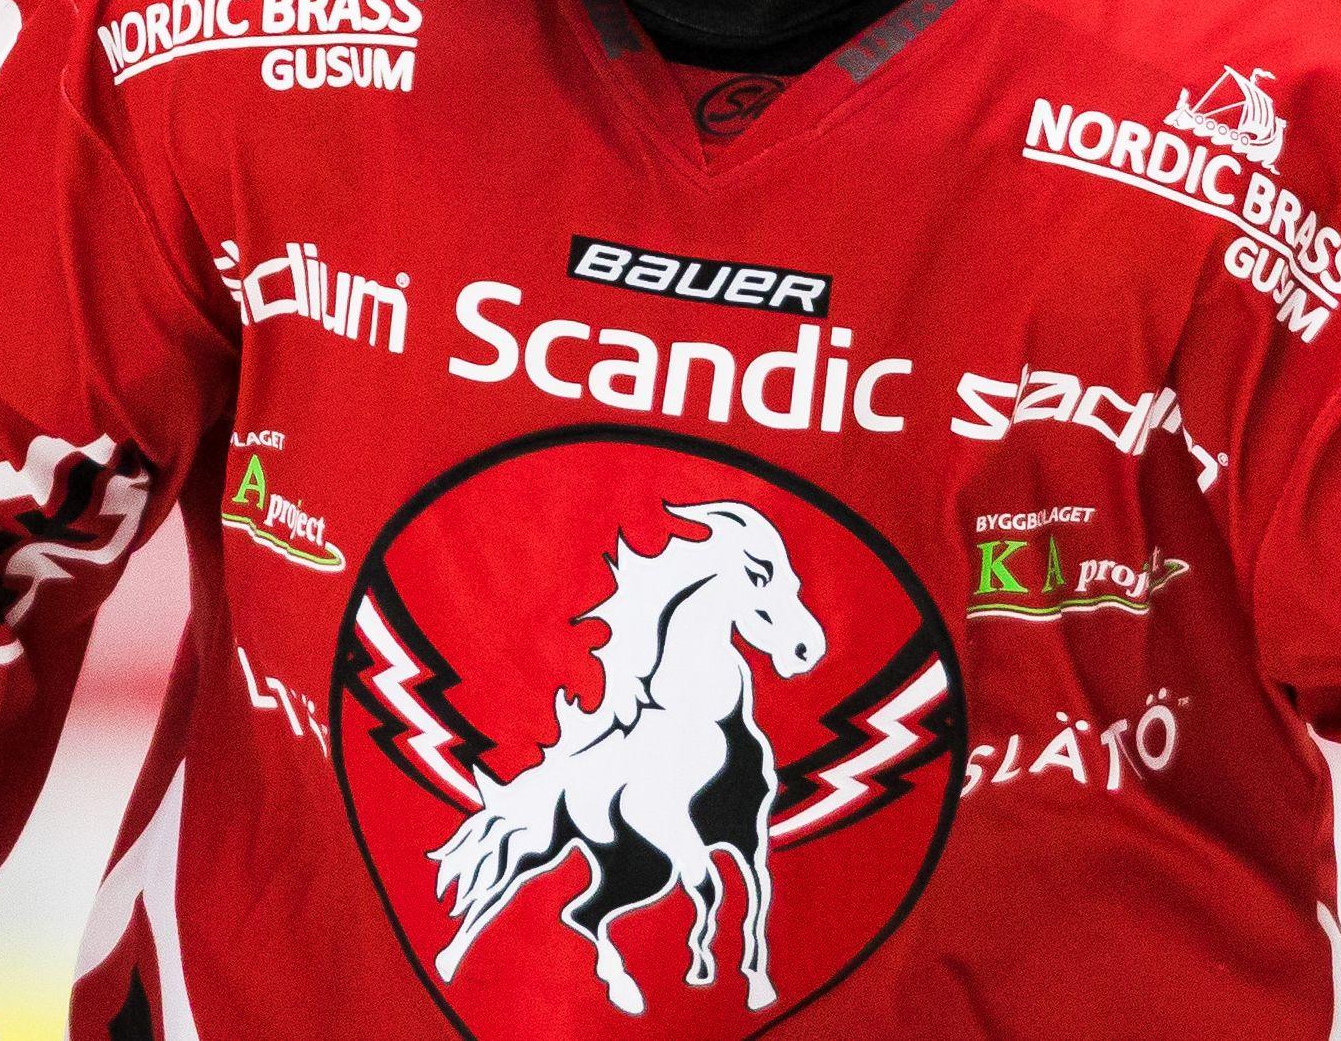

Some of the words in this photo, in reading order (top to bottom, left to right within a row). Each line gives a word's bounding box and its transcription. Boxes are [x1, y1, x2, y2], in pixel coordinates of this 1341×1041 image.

[261, 46, 416, 92] GUSUM
[1025, 97, 1242, 207] NORDIC
[448, 280, 913, 433] Scandic
